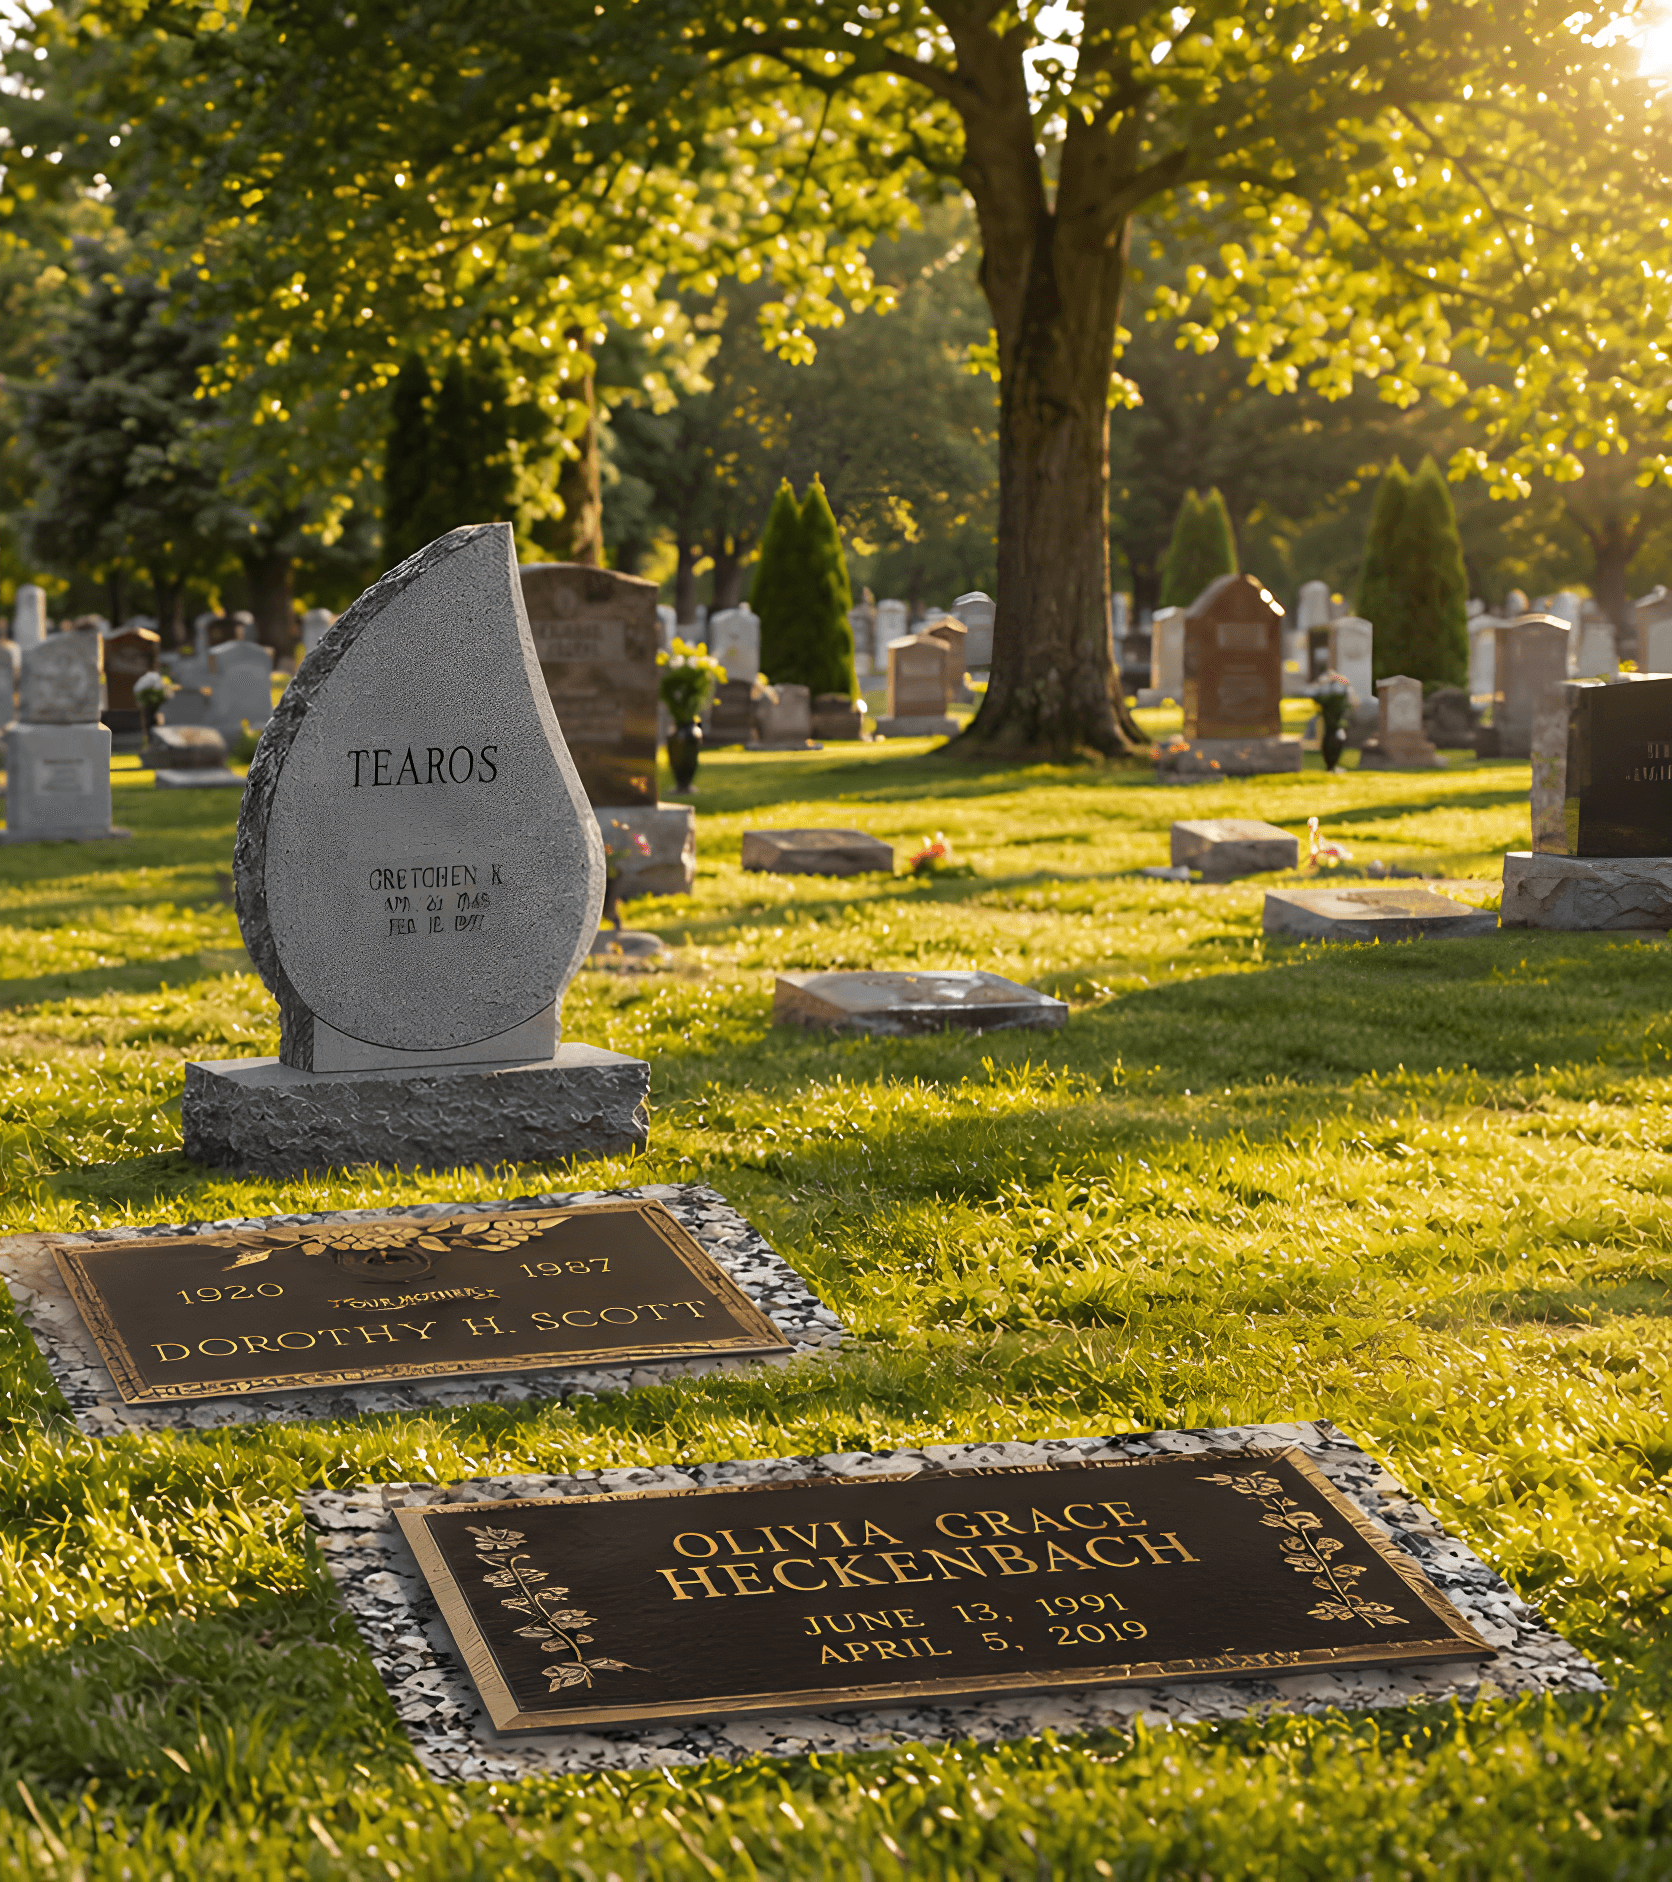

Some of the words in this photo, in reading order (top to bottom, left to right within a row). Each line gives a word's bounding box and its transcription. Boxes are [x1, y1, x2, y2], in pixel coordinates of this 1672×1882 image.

[348, 745, 498, 788] TEAROS
[176, 1283, 284, 1306] 1920
[520, 1258, 613, 1279] 1987
[150, 1321, 437, 1363] DOROTHY
[461, 1315, 517, 1336] H.
[533, 1300, 706, 1332] SCOTT
[673, 1519, 904, 1560] OLIVIA
[935, 1500, 1148, 1541] GRACE
[657, 1531, 1201, 1602] HECKENBACH
[803, 1609, 925, 1637] JUNE
[954, 1600, 1014, 1626] 13,
[1032, 1592, 1129, 1614] 1991
[817, 1636, 952, 1664] APRIL
[984, 1631, 1025, 1653] 5,
[1048, 1621, 1150, 1647] 2019
